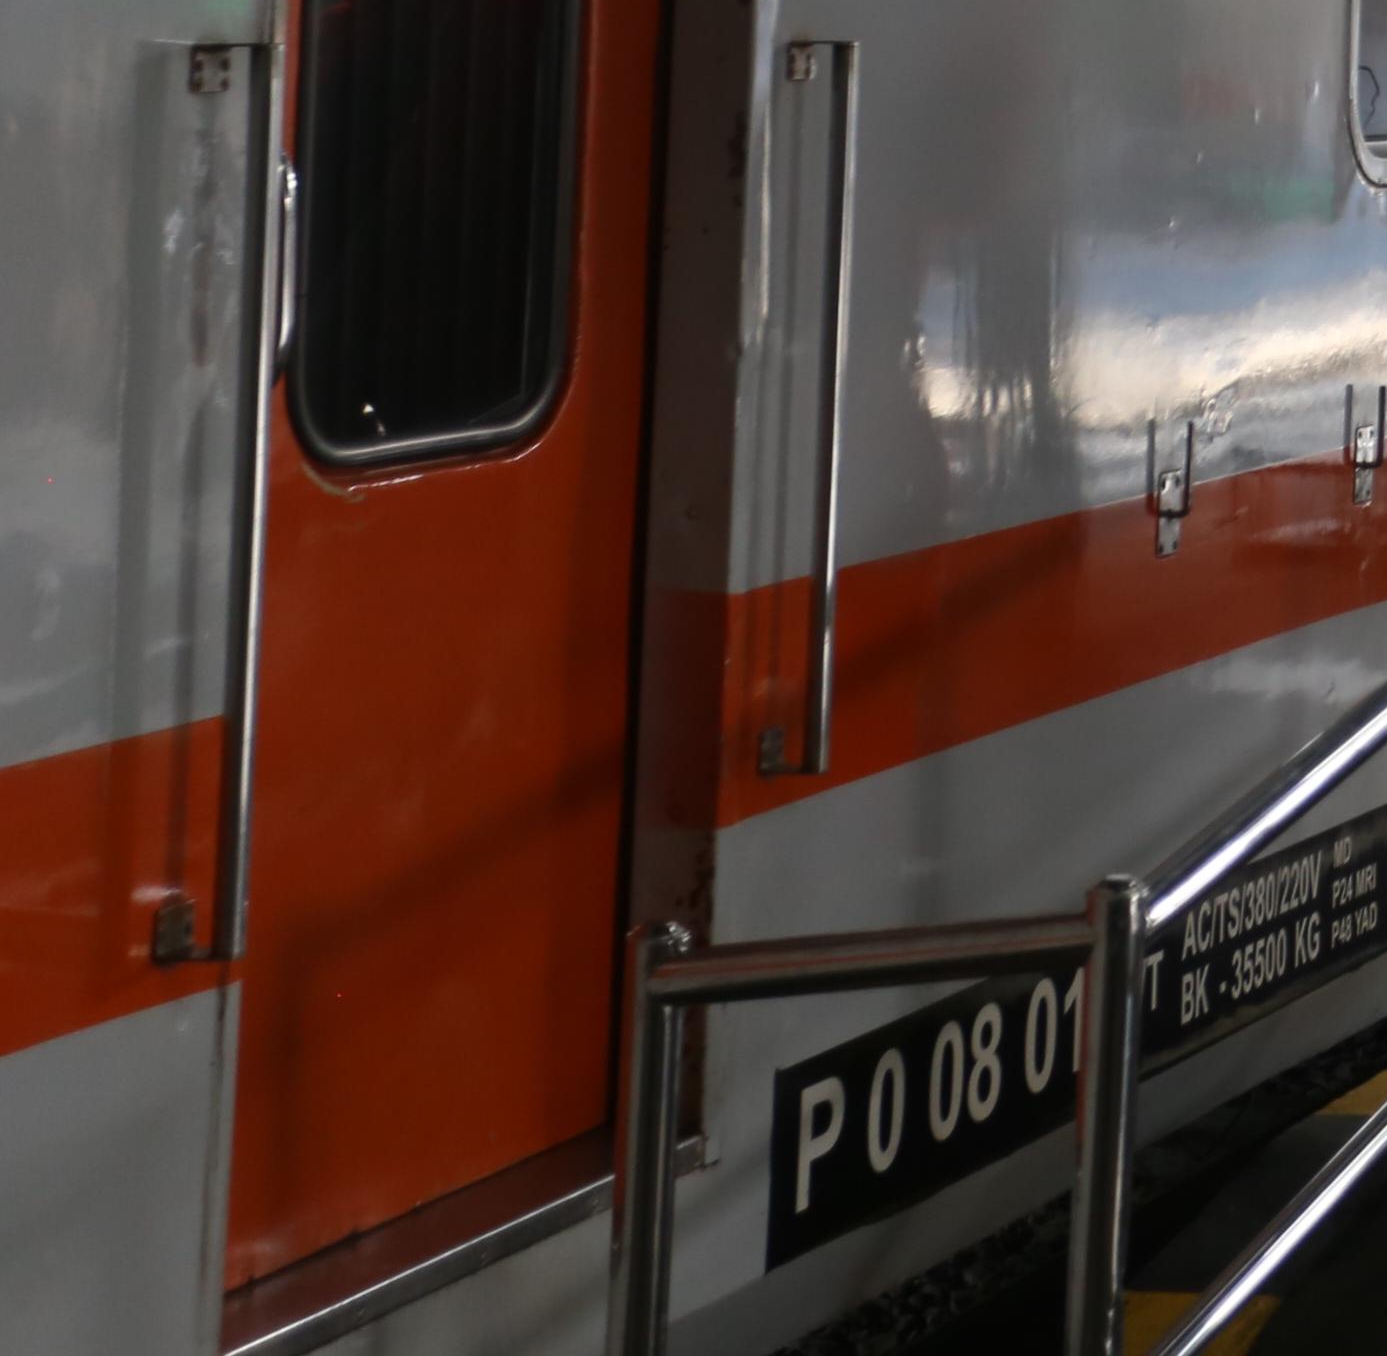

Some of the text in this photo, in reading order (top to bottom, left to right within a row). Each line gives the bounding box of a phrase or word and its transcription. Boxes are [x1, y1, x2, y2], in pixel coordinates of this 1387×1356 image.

[1331, 875, 1354, 909] P24
[1354, 862, 1378, 899] MRI
[1333, 836, 1352, 868] MD
[1180, 850, 1324, 961] AC/TS/380/220V
[1330, 915, 1353, 950] P48
[1354, 902, 1379, 939] YAD
[1180, 963, 1211, 1027] BK
[1293, 911, 1322, 970] KG
[793, 1075, 847, 1216] P
[866, 1046, 907, 1175] 0
[927, 1001, 1004, 1143] 08
[1023, 966, 1086, 1095] 01
